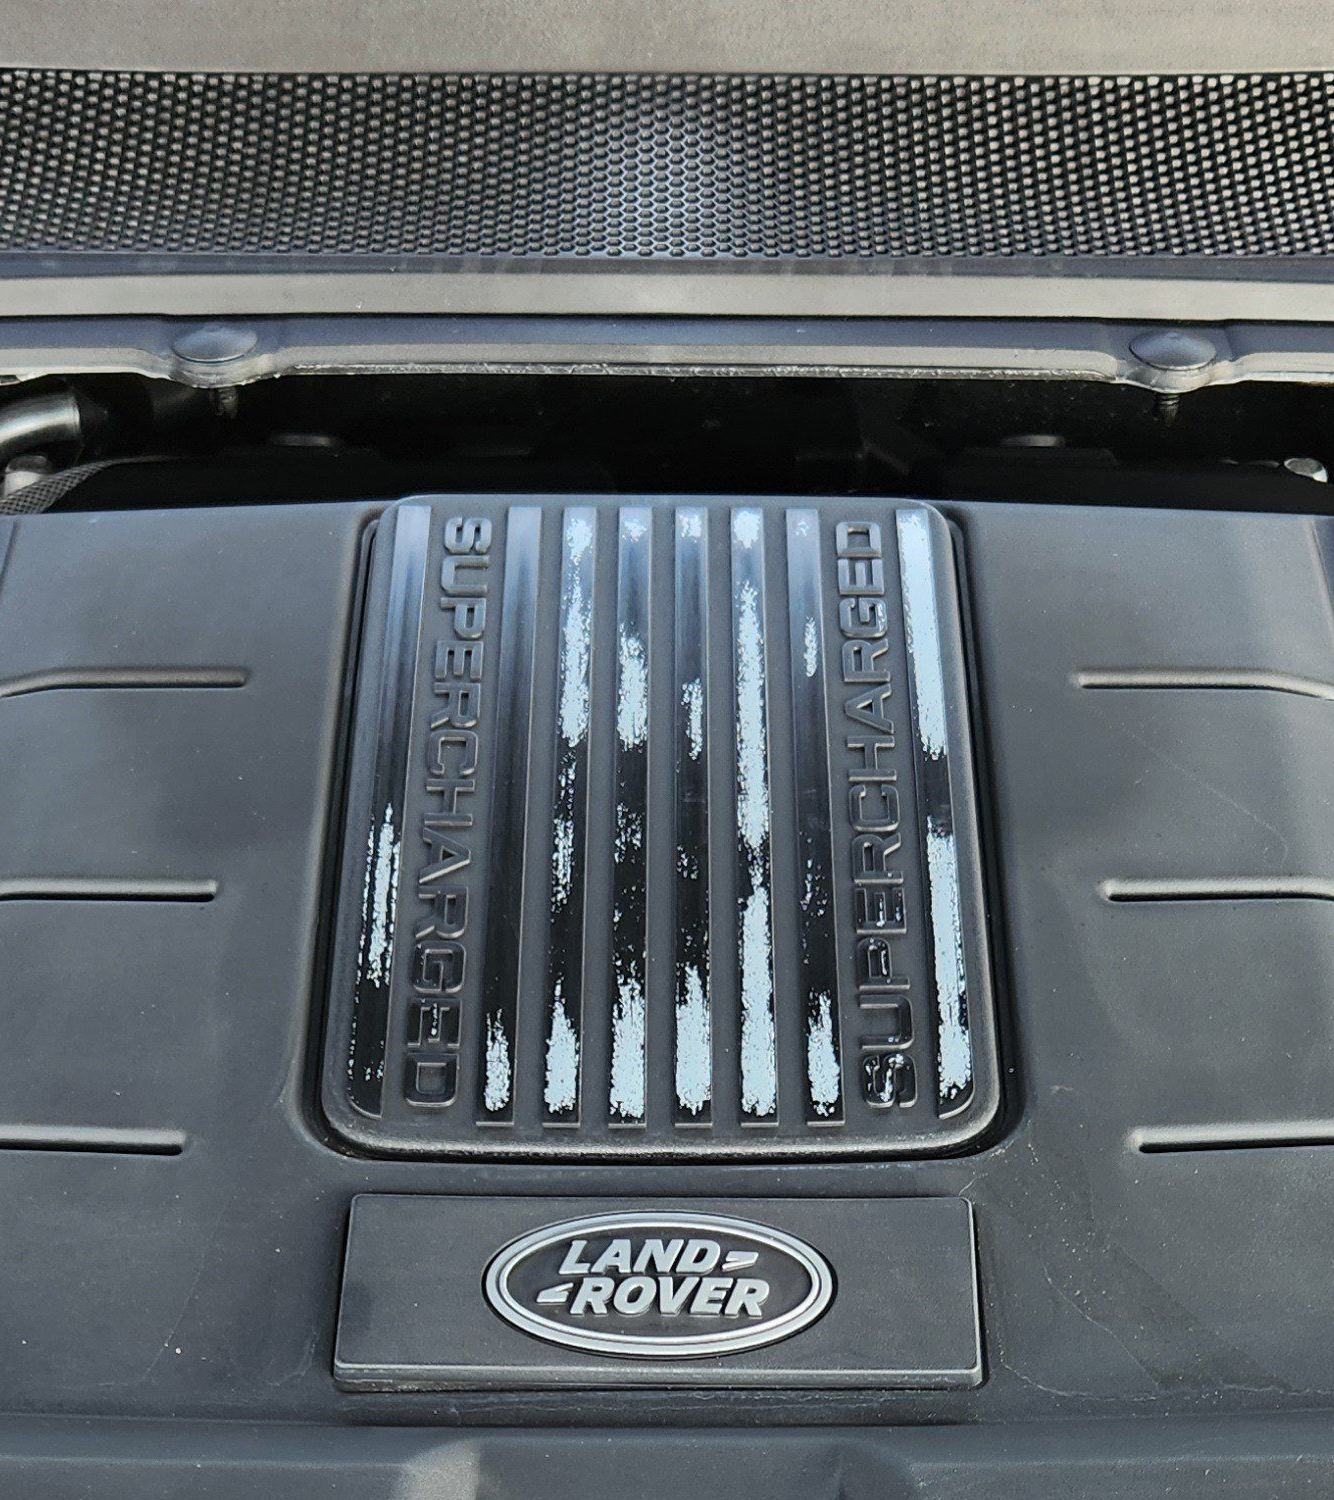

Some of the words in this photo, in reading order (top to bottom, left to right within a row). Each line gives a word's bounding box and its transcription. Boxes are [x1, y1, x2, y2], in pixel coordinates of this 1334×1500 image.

[403, 516, 492, 1108] SUPERCHARGED
[836, 520, 919, 1109] SUPERCHARGED
[557, 1238, 722, 1275] LAND
[570, 1276, 770, 1317] ROVER
